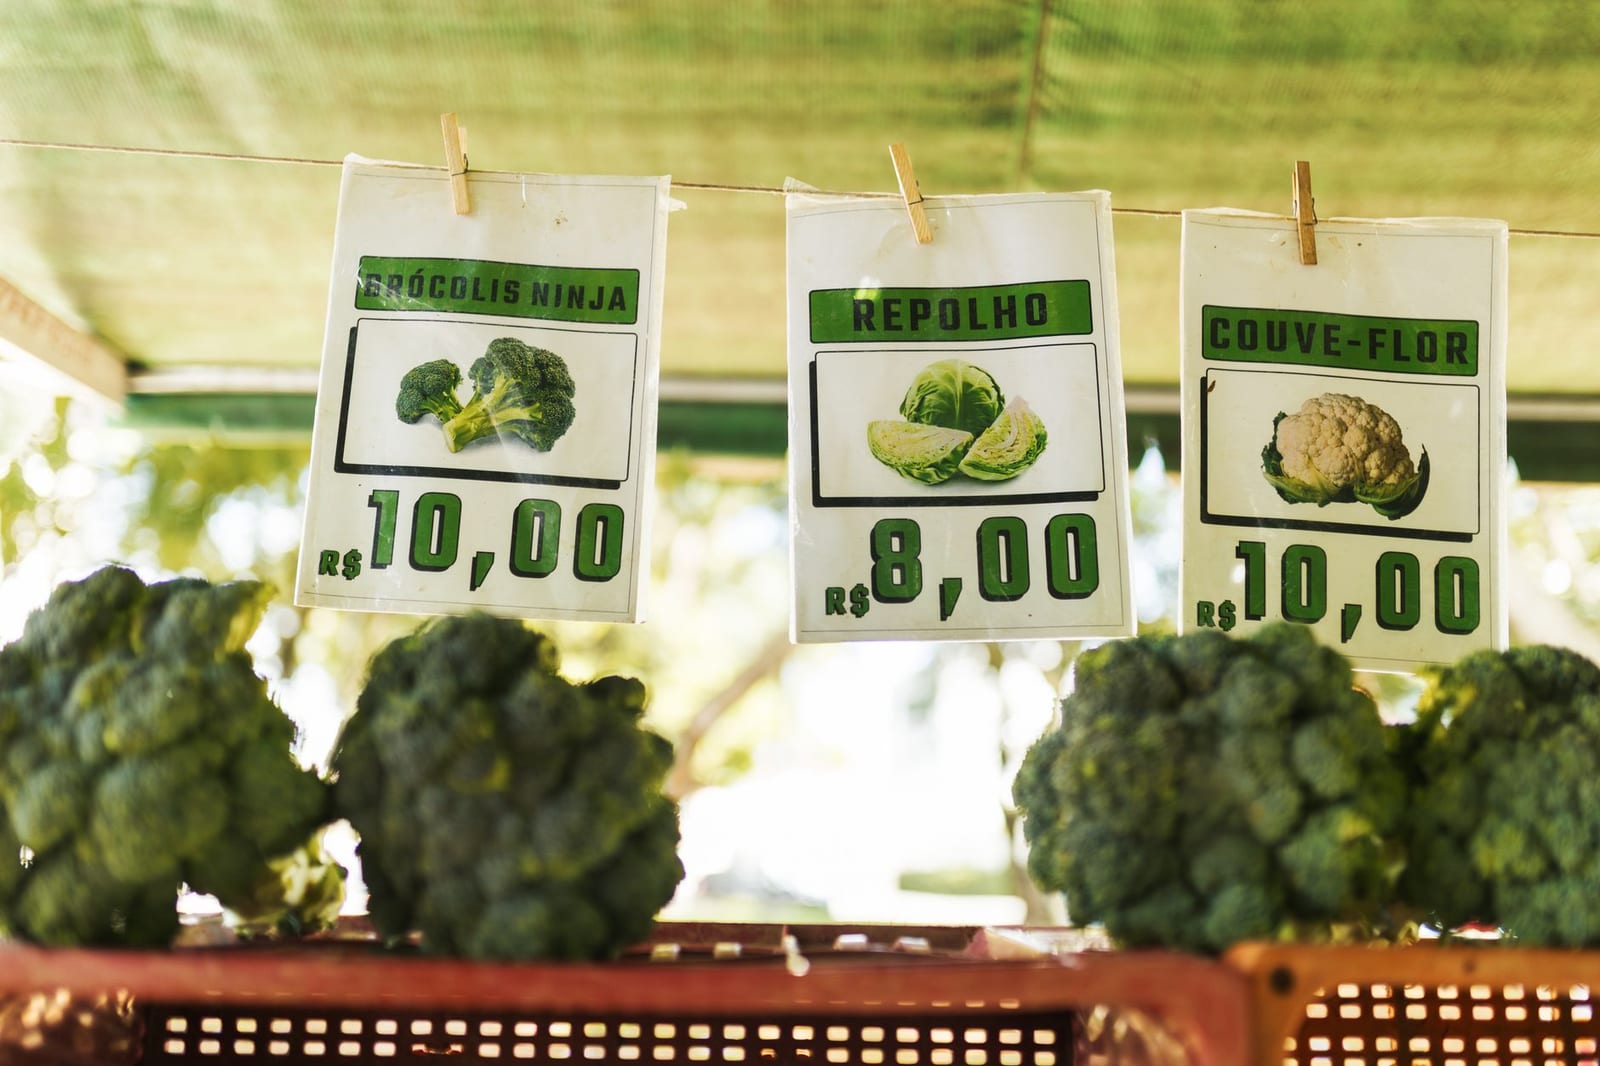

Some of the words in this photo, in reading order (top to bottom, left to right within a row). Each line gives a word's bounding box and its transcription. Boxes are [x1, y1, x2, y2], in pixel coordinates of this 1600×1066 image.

[363, 269, 520, 304] BRÓCOLIS
[531, 283, 627, 311] NINJA
[852, 293, 1048, 332] REPOLHO
[1209, 317, 1469, 365] COUVE-FLOR
